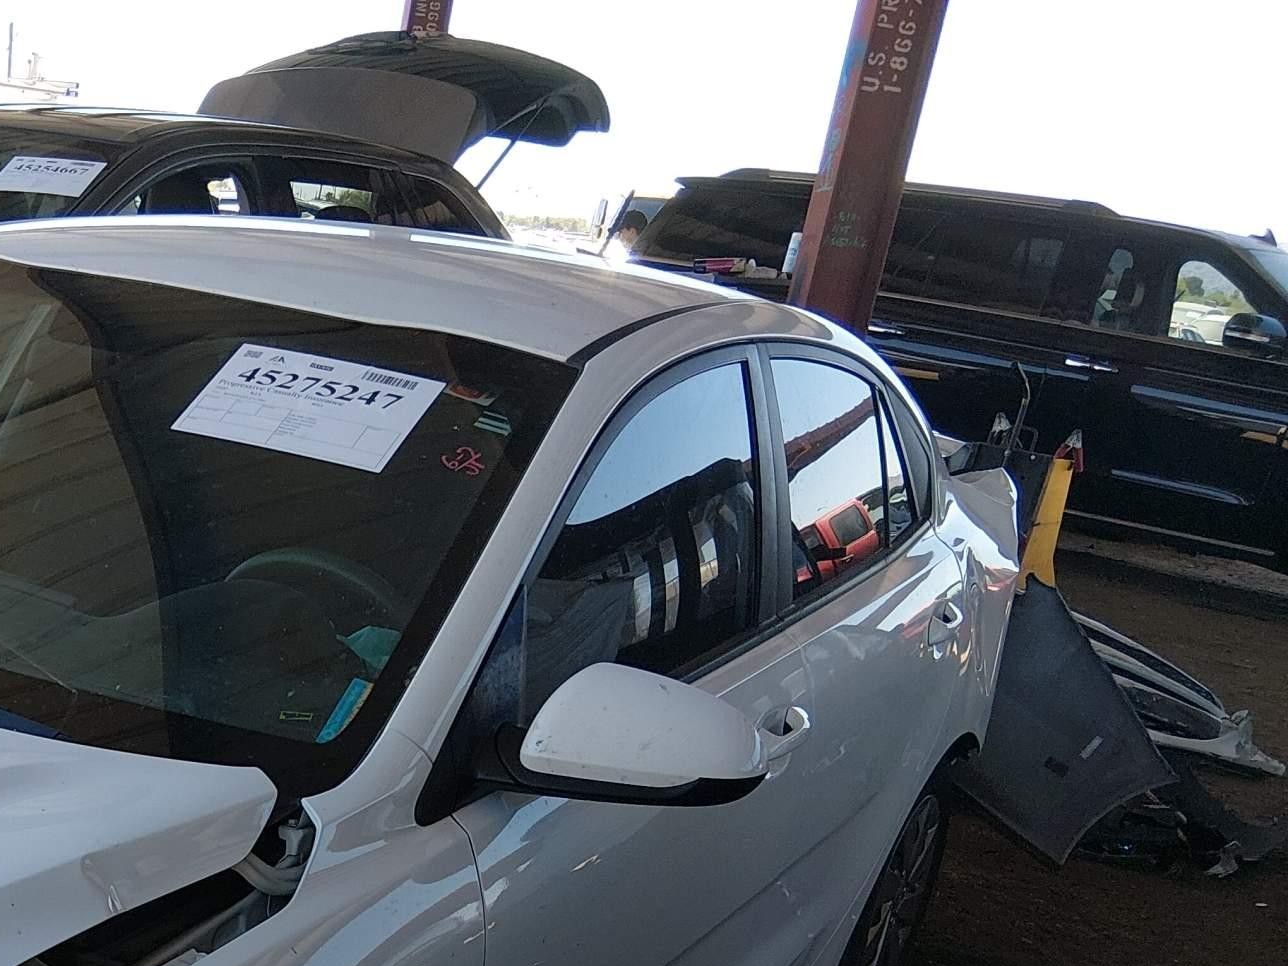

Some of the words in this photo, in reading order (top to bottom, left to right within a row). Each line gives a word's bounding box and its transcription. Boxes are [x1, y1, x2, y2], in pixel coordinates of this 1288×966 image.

[415, 0, 427, 17] IN
[861, 46, 889, 92] U.S.
[237, 366, 404, 409] 45275247
